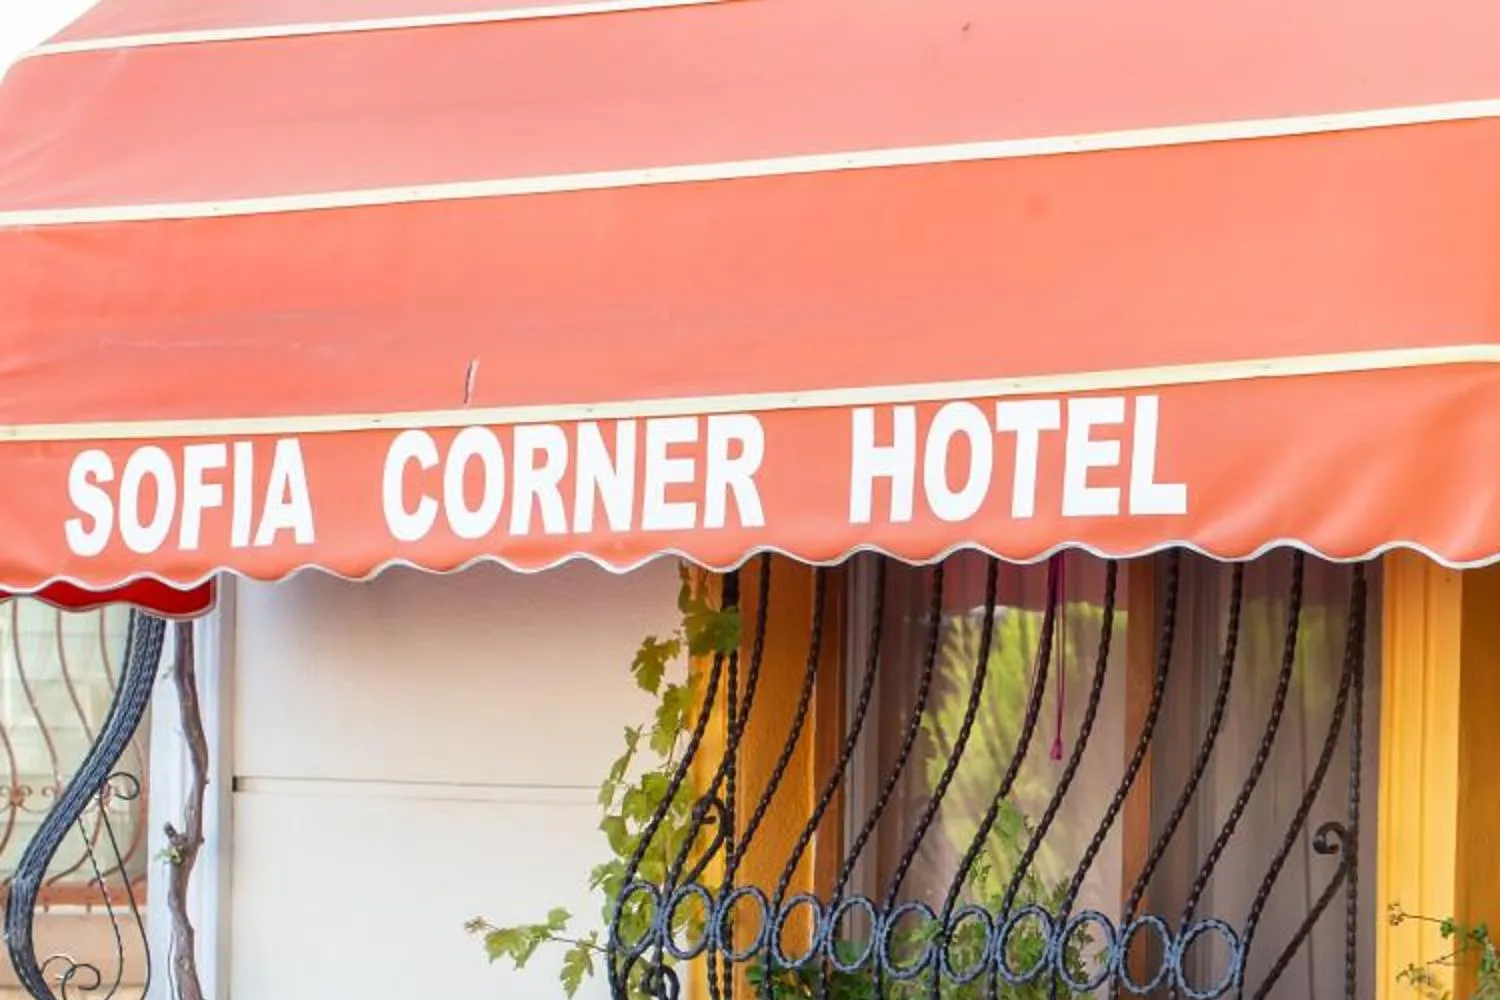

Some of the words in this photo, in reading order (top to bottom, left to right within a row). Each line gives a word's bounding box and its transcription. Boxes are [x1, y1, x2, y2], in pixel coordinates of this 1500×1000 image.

[64, 438, 315, 557] SOFIA
[381, 414, 766, 542] CORNER
[848, 394, 1188, 524] HOTEL
